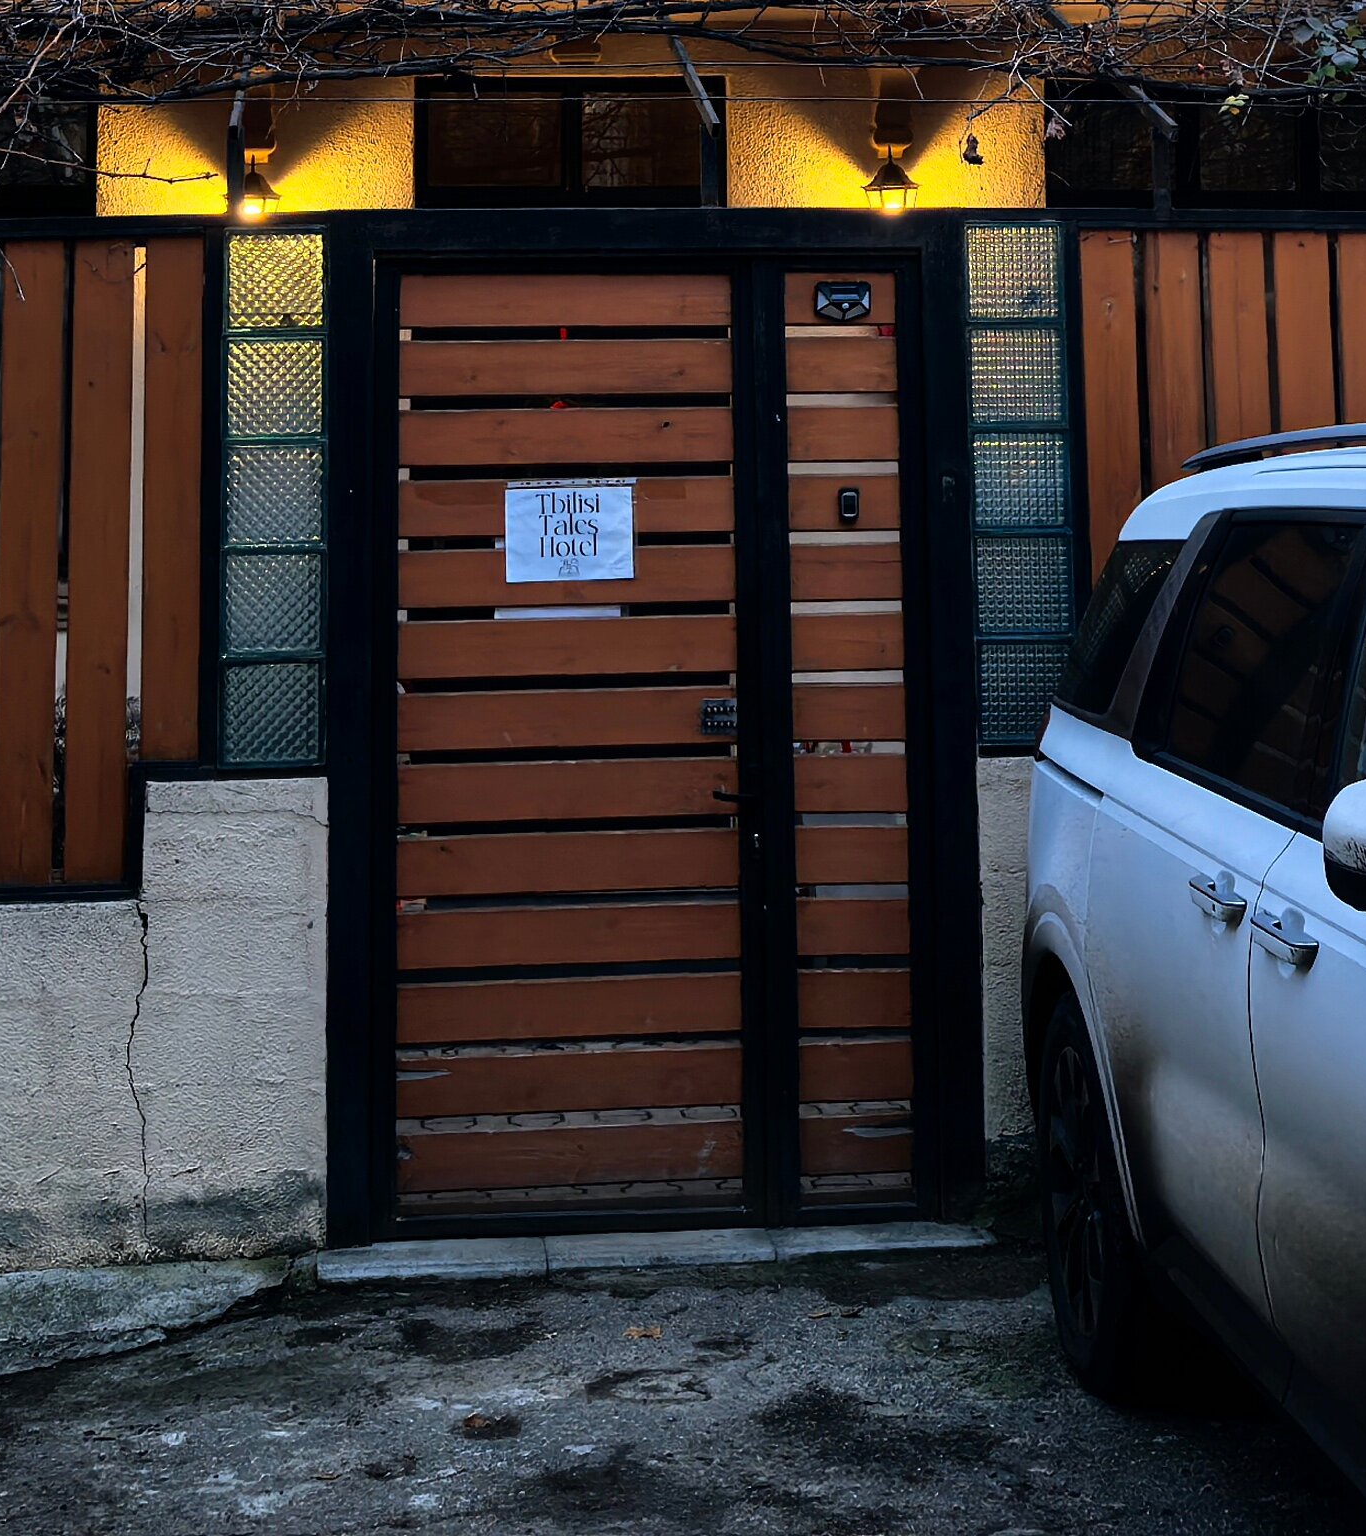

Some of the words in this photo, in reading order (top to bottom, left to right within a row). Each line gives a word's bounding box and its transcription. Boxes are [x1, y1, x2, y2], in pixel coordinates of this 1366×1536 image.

[536, 491, 600, 514] Tbilisi
[539, 514, 599, 536] Tales
[540, 533, 598, 558] Hotel
